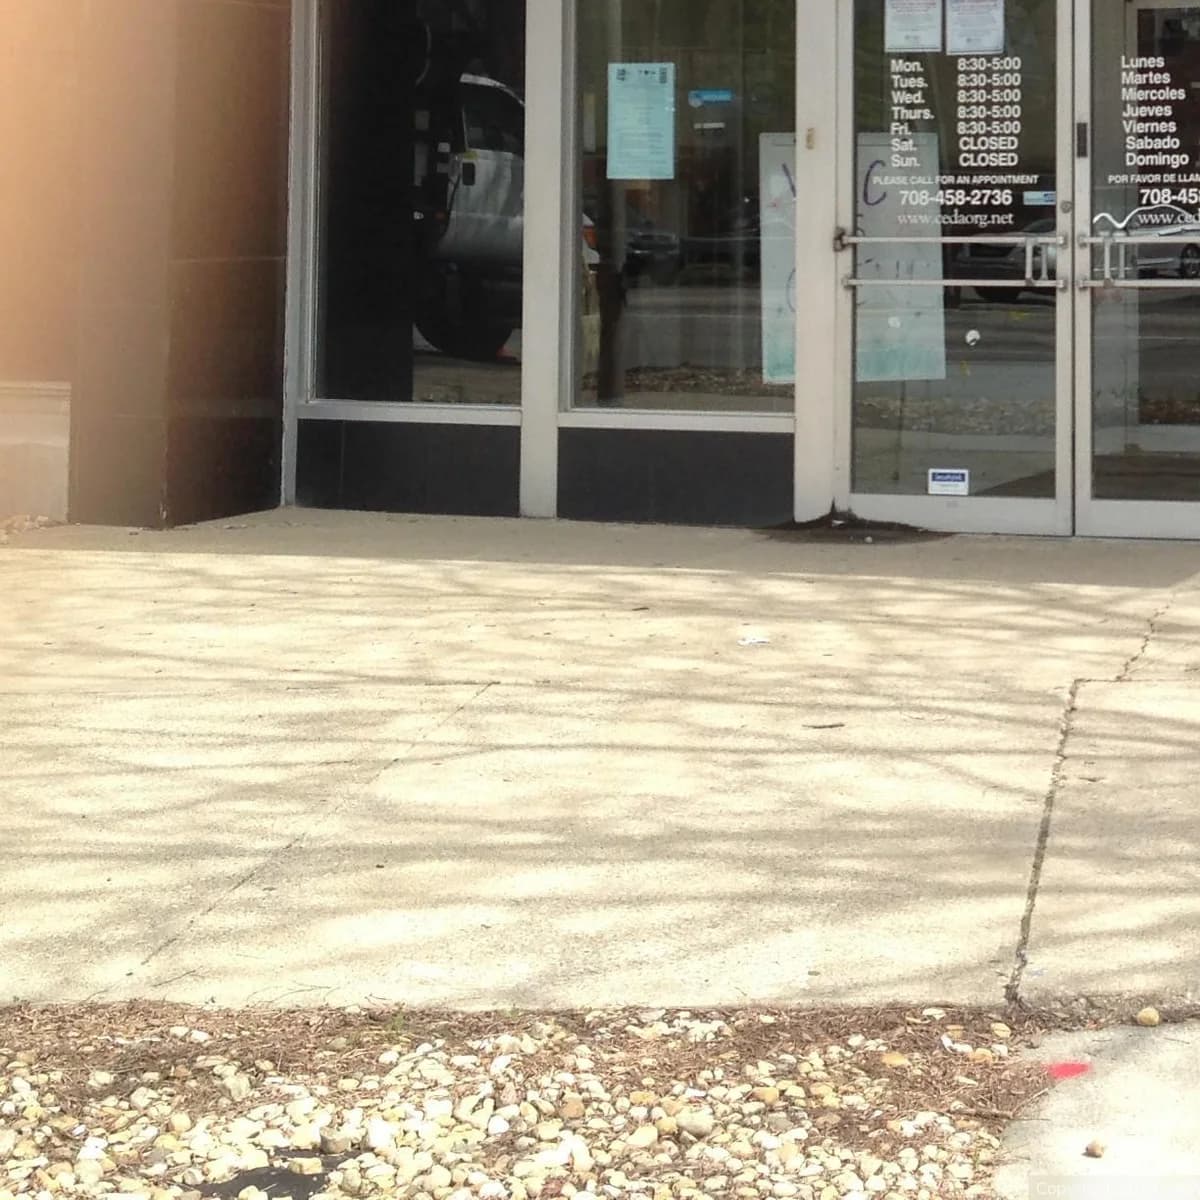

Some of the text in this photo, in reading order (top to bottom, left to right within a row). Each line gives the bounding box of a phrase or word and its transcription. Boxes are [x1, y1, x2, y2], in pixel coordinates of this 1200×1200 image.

[891, 57, 1021, 72] Mon. 8:30-5:00
[1121, 56, 1165, 68] Lunes
[892, 73, 1021, 88] Tues. 8:30-5:00
[1121, 72, 1171, 84] Martes
[892, 89, 1021, 103] Wed. 8:30-5:00
[1121, 87, 1186, 100] Miercoles
[892, 105, 1021, 120] Thurs. 8:30-5:00
[1123, 104, 1172, 117] Jueves
[890, 121, 1021, 135] Fri. 8:30-5:00
[1123, 120, 1177, 133] Viernes
[890, 137, 1018, 151] Sat. CLOSED
[1126, 136, 1180, 149] Sabado
[891, 153, 1018, 167] Sun. CLOSED
[1126, 152, 1190, 168] Domingo
[873, 175, 1039, 185] PLEASE CALL FOR AN APPOINTMENT
[1108, 175, 1129, 183] POR
[1130, 174, 1161, 183] FAVOR
[1163, 174, 1176, 183] DE
[900, 189, 1013, 205] 708-458-2736
[898, 209, 1014, 227] www.cedaorg.net
